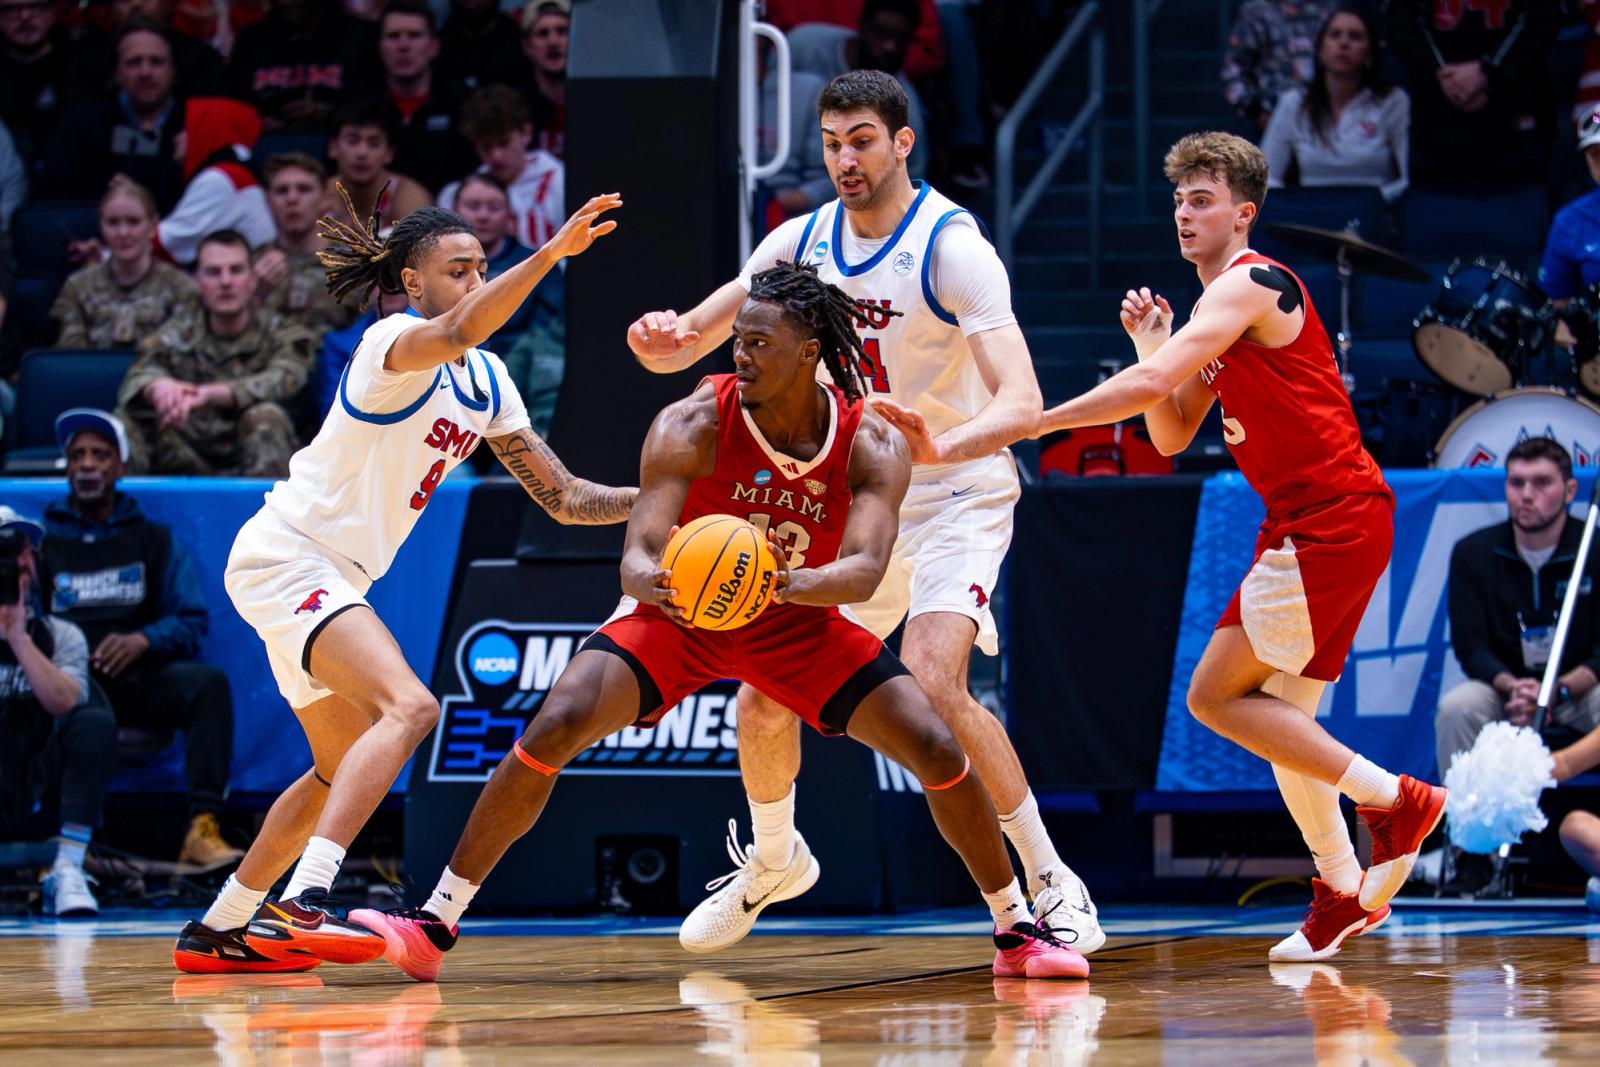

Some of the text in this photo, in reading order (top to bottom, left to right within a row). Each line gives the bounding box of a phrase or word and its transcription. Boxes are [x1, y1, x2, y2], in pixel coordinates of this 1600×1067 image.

[409, 459, 446, 511] 9
[731, 482, 827, 524] MIAM
[703, 551, 751, 619] Wilson
[743, 571, 772, 620] NCAA
[474, 657, 517, 673] NCAA
